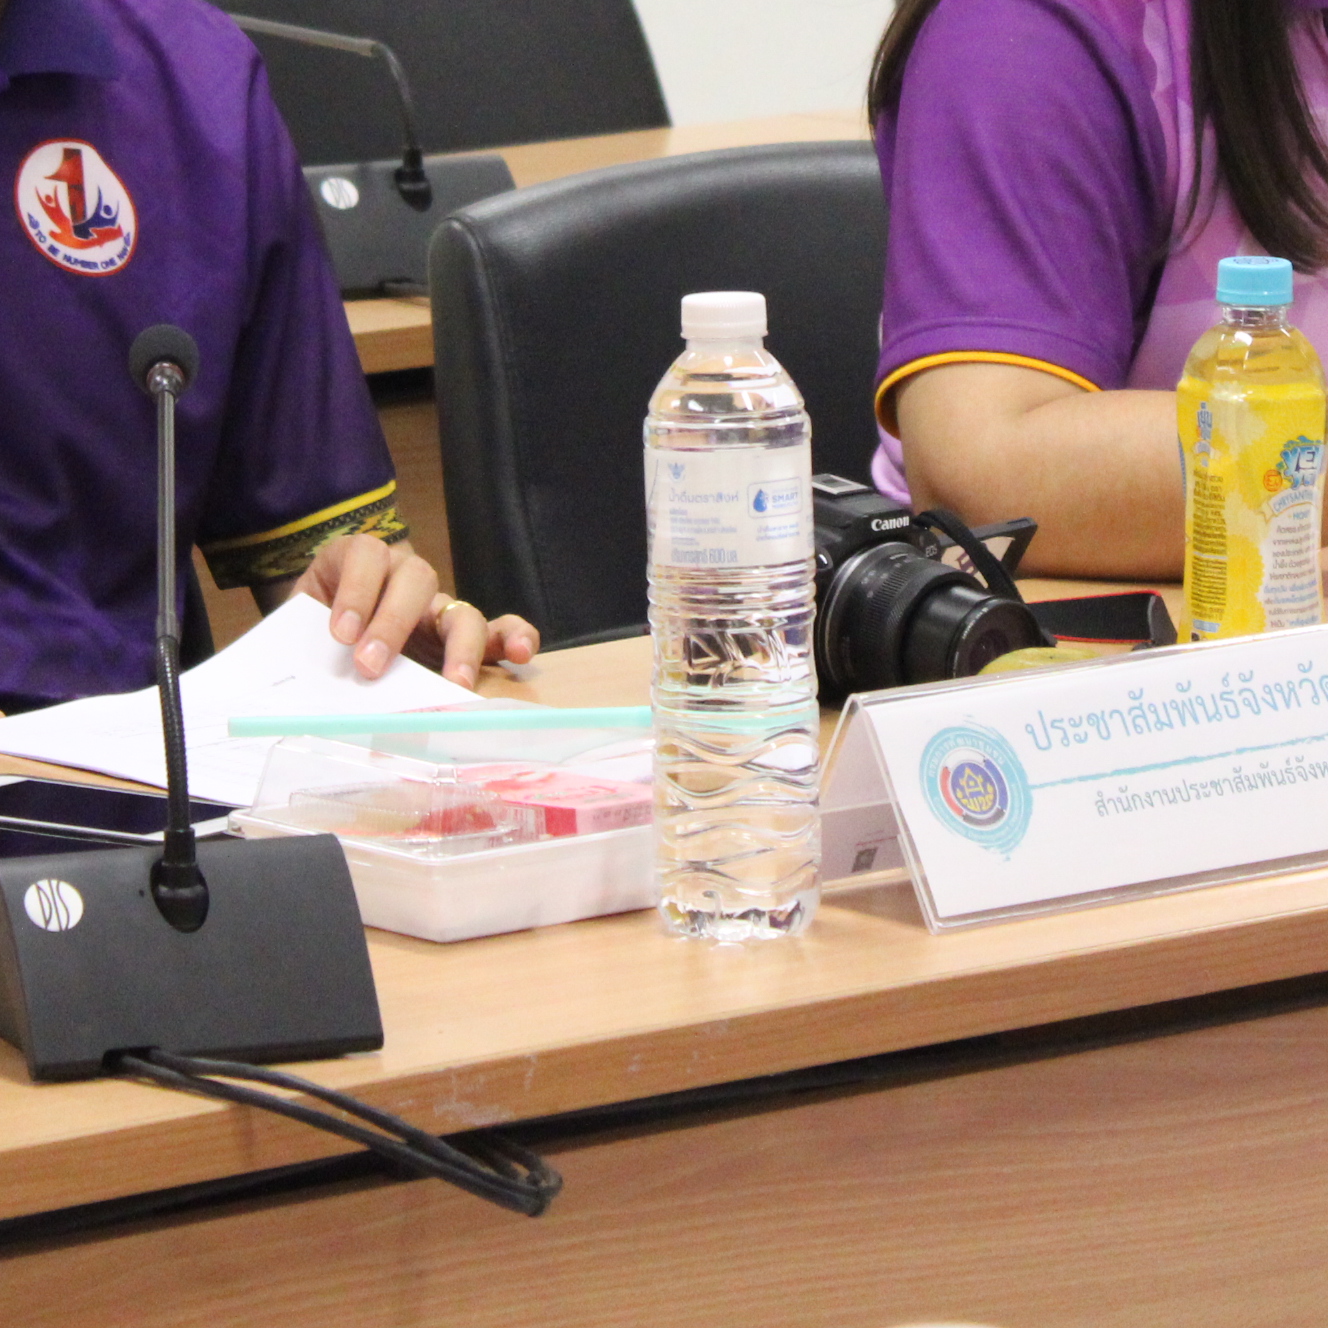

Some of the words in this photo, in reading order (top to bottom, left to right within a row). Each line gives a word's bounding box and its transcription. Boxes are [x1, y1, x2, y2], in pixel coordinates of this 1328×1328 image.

[35, 230, 47, 244] TO
[63, 254, 100, 270] NUMBER
[100, 257, 118, 270] ONE
[772, 491, 799, 503] SMART
[871, 516, 910, 531] Canon
[926, 544, 938, 558] EOS
